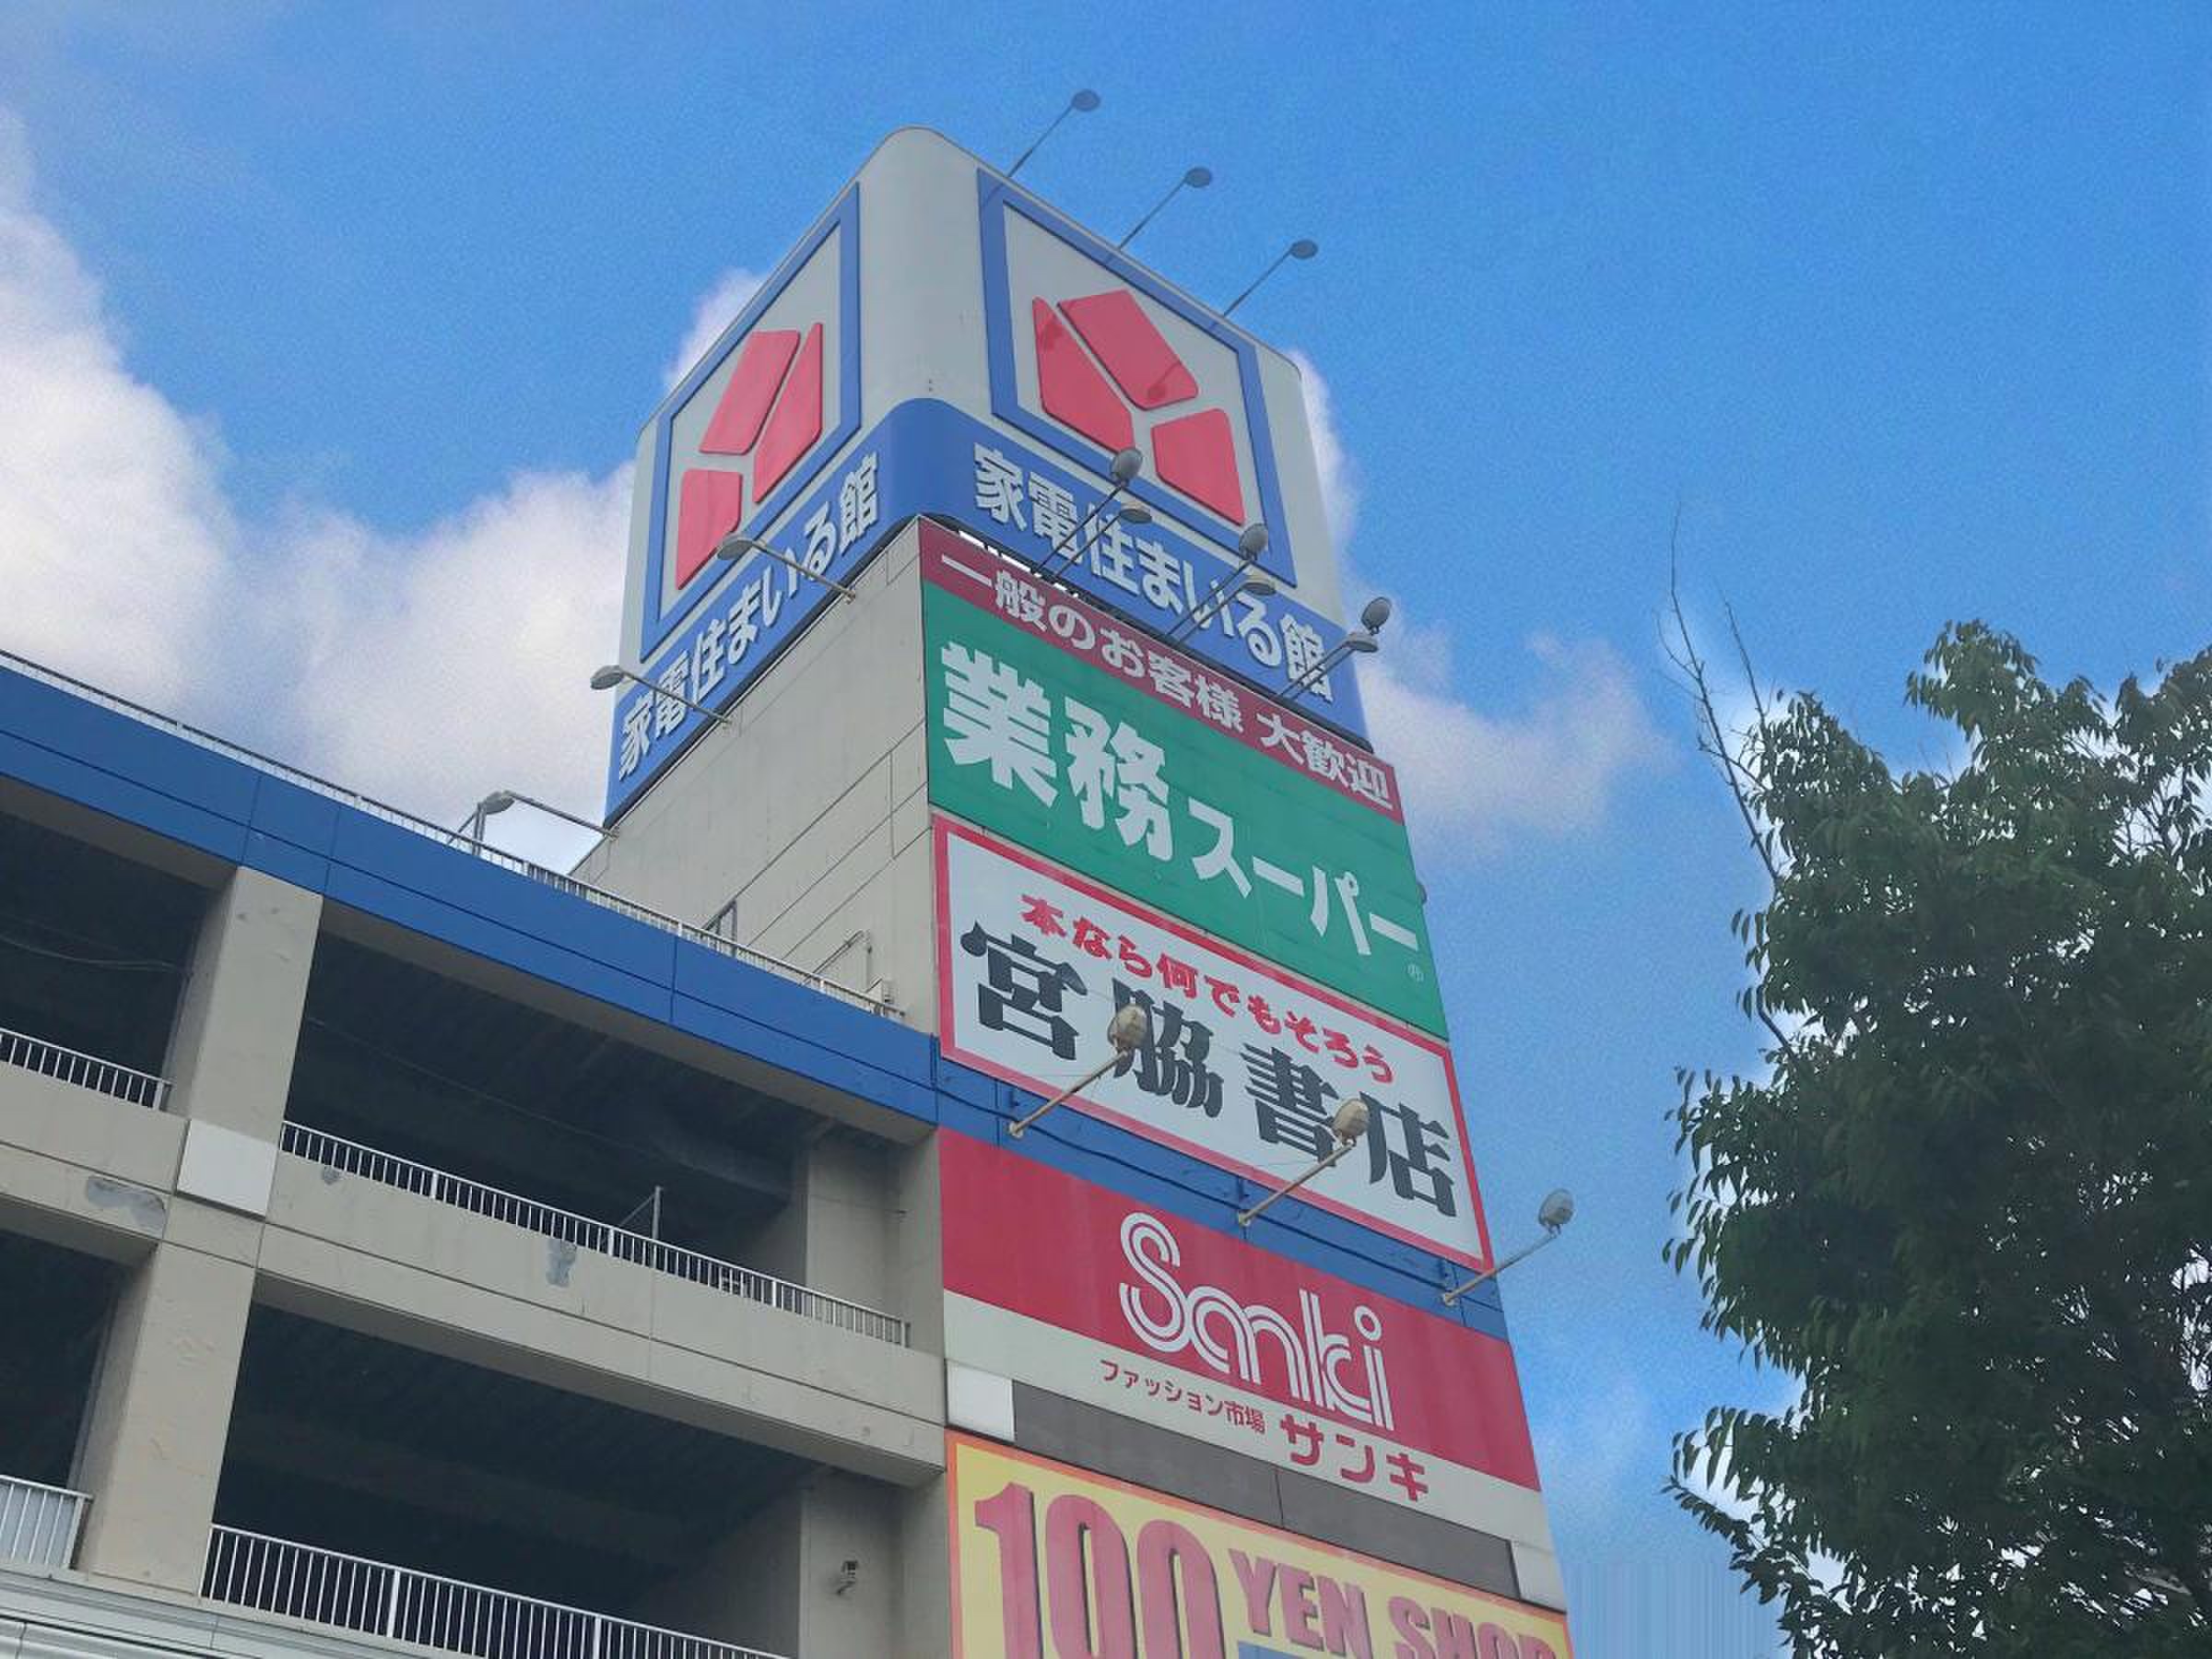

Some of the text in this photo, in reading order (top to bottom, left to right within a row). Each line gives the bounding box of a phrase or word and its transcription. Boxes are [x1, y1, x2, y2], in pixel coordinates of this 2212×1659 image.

[618, 452, 879, 782] 家電住まいる館
[941, 554, 1394, 811] 一般のお客様 大歓迎
[973, 442, 1334, 702] 家電住まいる館
[941, 641, 1418, 956] 業務スーパー
[960, 921, 1457, 1218] 宮脇書店
[1021, 894, 1394, 1085] 本なら何でもそろう
[1100, 1359, 1430, 1503] ファッション市場 サンキ
[1119, 1211, 1394, 1431] Sanki
[974, 1481, 1227, 1659] 100
[1229, 1548, 1374, 1659] YEN
